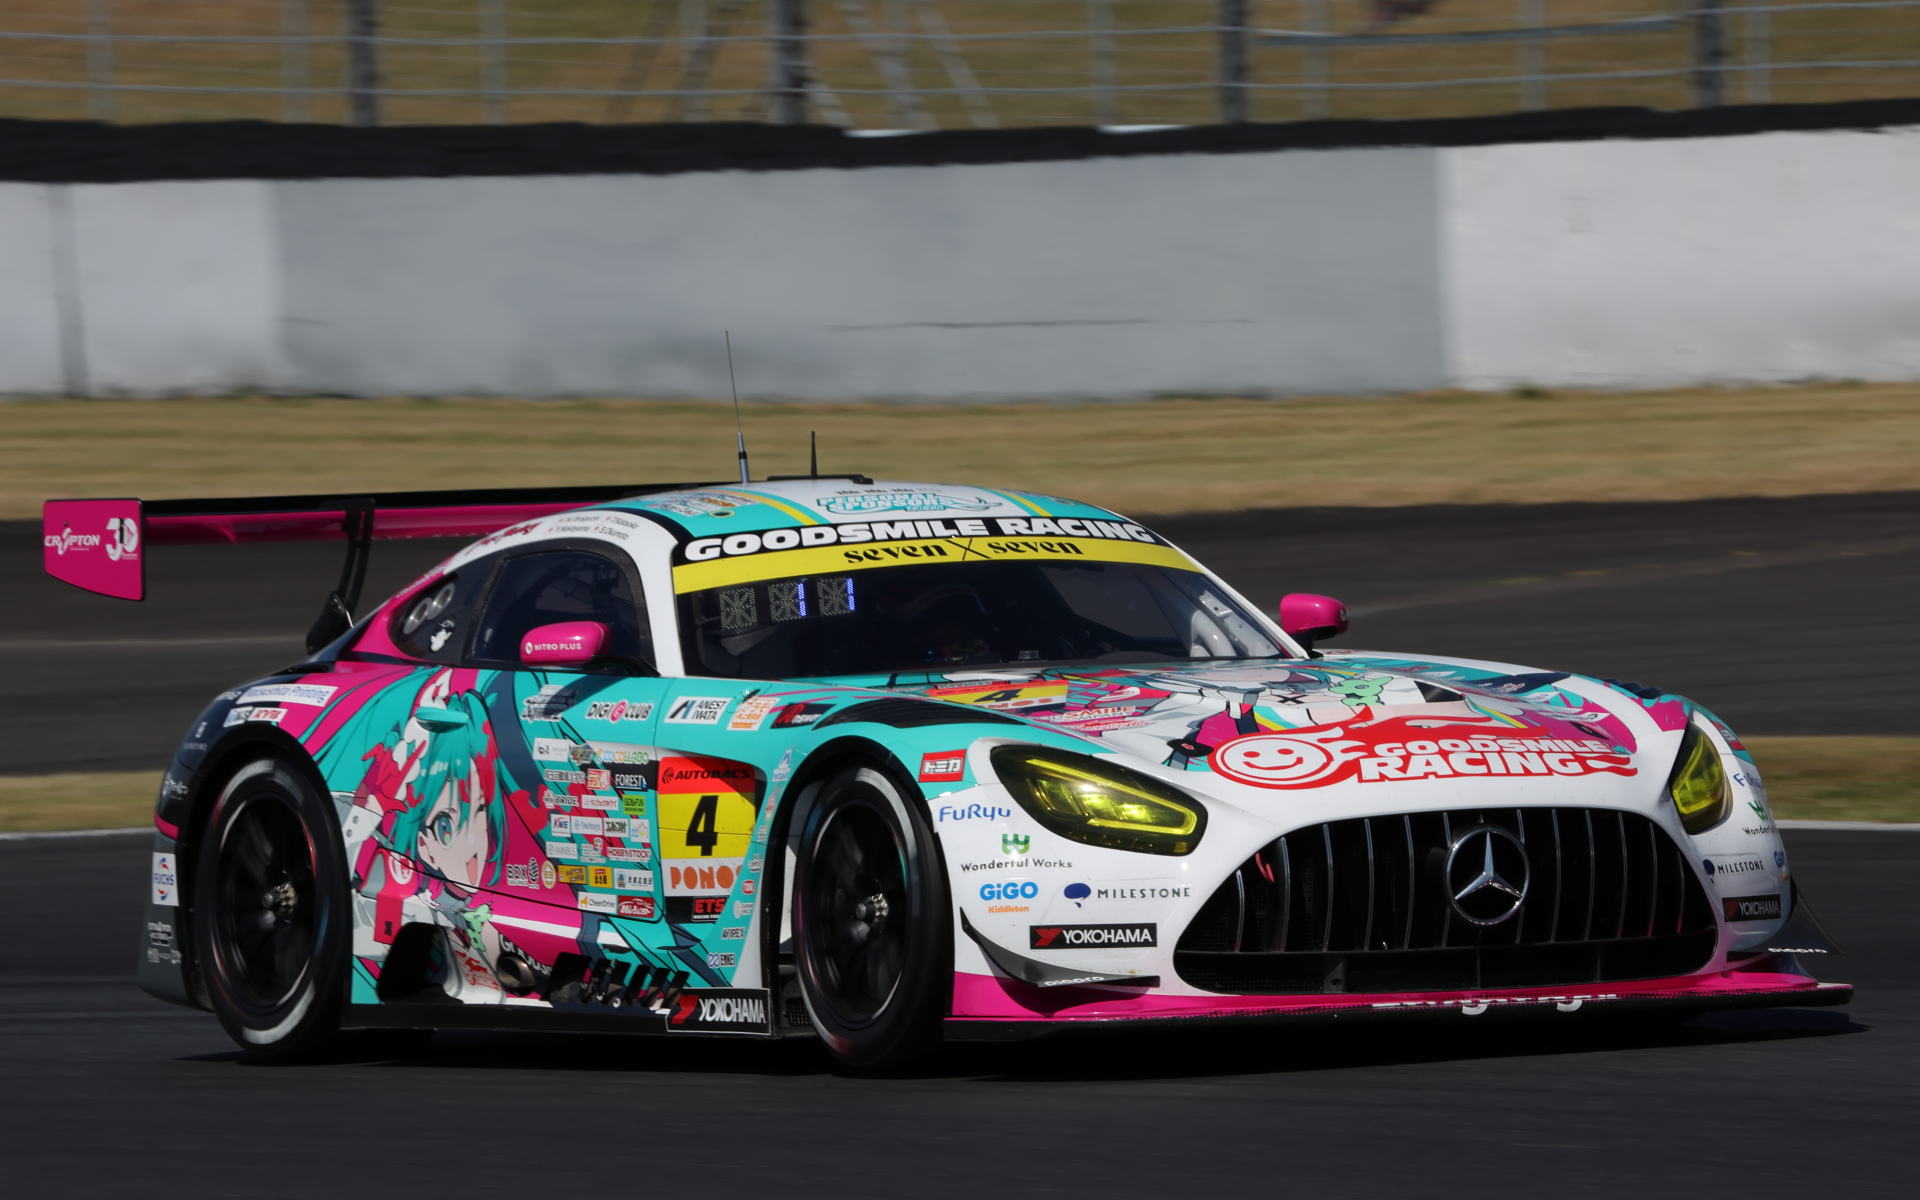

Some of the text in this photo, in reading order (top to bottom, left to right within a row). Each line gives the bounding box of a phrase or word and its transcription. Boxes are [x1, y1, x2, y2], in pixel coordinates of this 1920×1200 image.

[44, 527, 101, 555] CRYPTON
[684, 517, 1156, 561] GOODSMILE RACING
[843, 543, 949, 564] seven
[986, 540, 1086, 556] seven
[533, 643, 582, 652] NITRO PLUS
[973, 688, 1025, 703] 4
[695, 700, 727, 710] ANEST
[1374, 739, 1612, 757] GOODSMILE
[923, 757, 963, 774] トミカ
[1359, 752, 1584, 780] RACING
[615, 774, 642, 786] FOREST
[674, 768, 751, 780] AUTOBACS
[554, 796, 578, 805] BRIDE
[939, 804, 1011, 822] FuRyu
[685, 795, 719, 856] 4
[507, 864, 528, 879] BOX
[961, 859, 1073, 872] Wonderful Works
[1717, 860, 1764, 875] MILESTONE
[154, 873, 174, 885] FUCHS
[979, 882, 1039, 901] GiGO
[1097, 888, 1191, 899] MILESTONE
[694, 898, 726, 914] ETS
[988, 905, 1030, 914] Kiddleton
[1739, 901, 1780, 916] YOKOHAMA
[721, 928, 745, 939] AVIREX
[1063, 929, 1152, 944] YOKOHAMA
[699, 998, 767, 1024] YOKOHAMA
